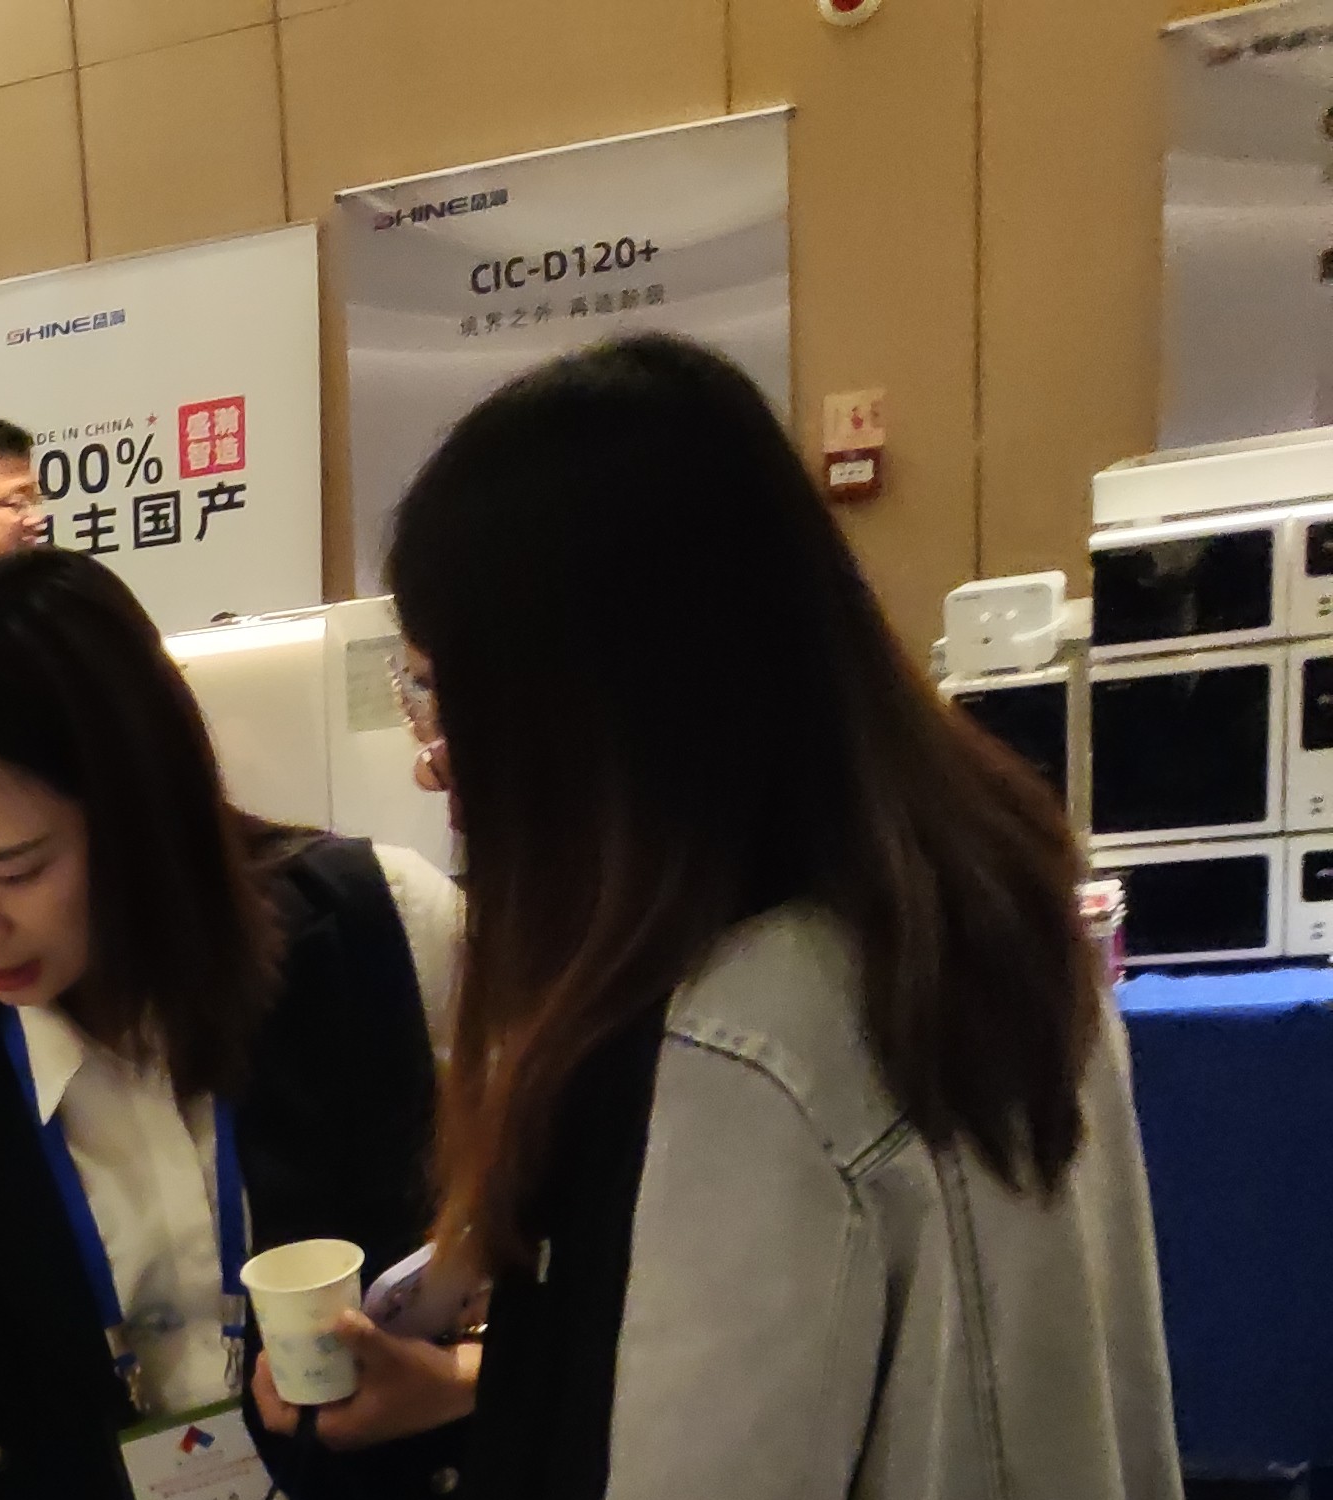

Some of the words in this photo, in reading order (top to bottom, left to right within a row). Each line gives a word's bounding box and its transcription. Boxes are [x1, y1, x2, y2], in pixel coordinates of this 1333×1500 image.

[470, 237, 660, 297] CIC-D120+
[62, 426, 79, 442] IN
[85, 417, 134, 438] CHINA
[37, 432, 164, 501] 00%
